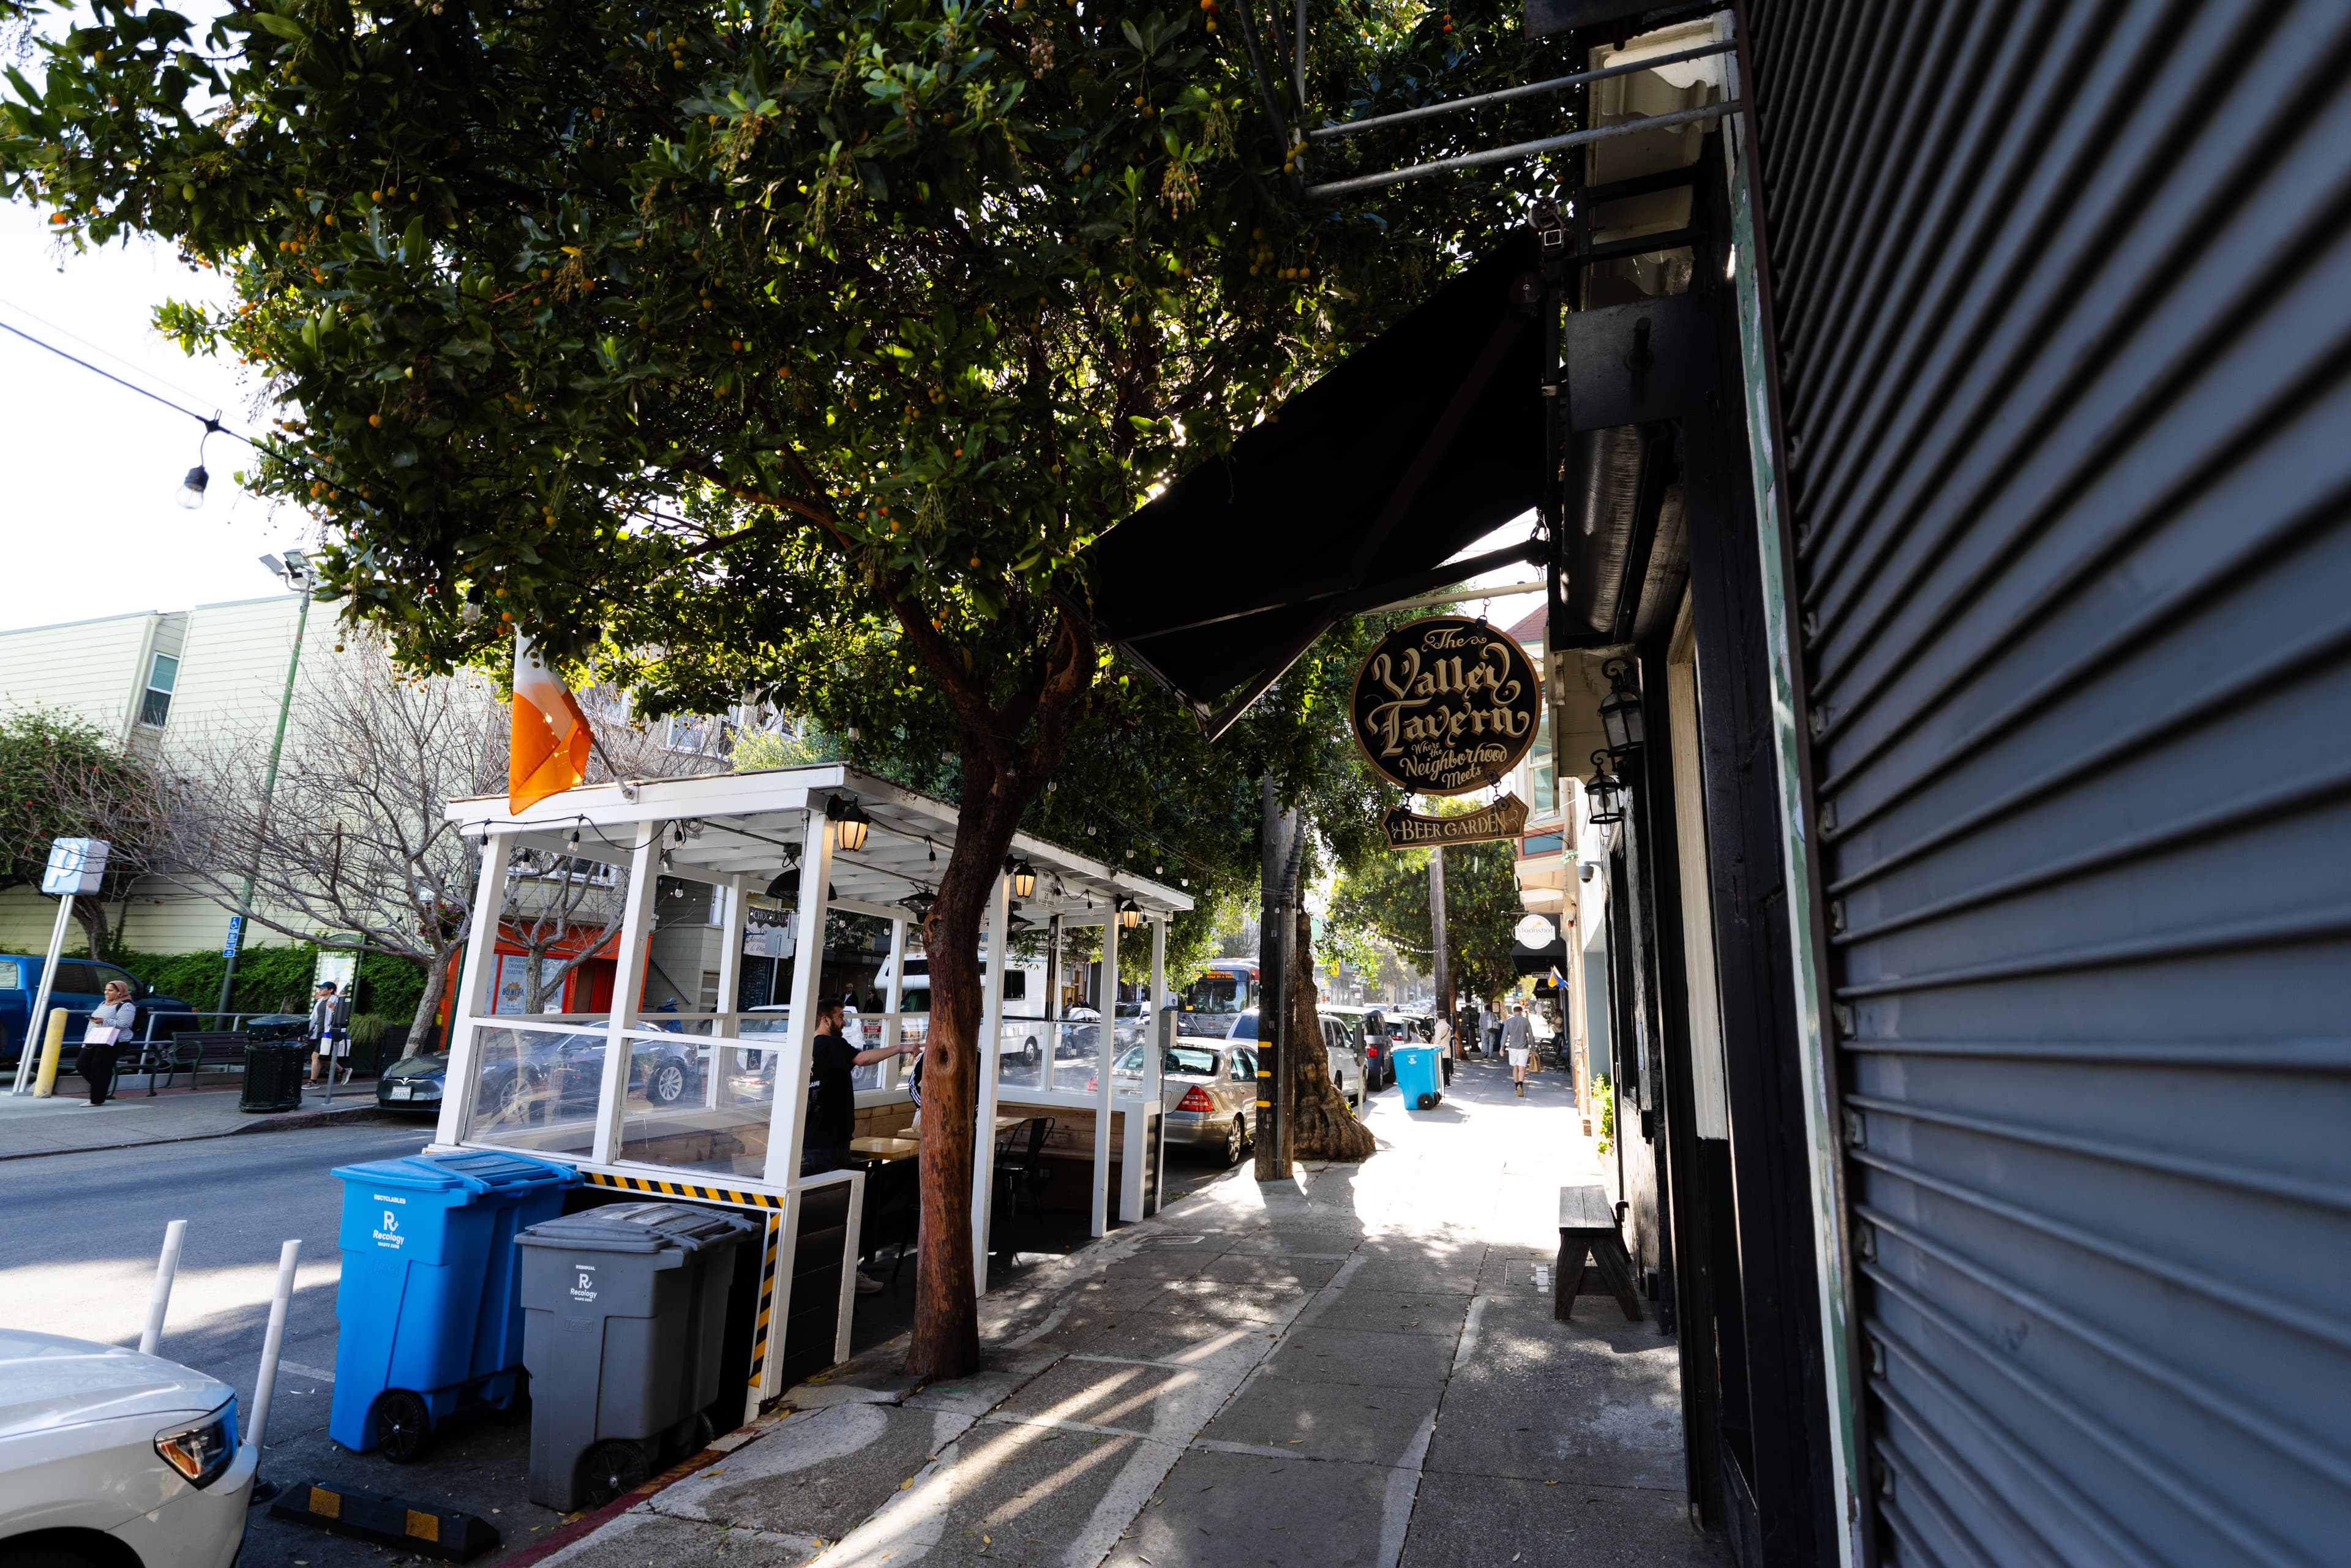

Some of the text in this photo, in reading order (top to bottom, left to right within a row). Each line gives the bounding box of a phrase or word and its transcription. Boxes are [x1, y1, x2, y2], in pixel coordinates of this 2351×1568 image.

[1421, 626, 1487, 652] The
[1371, 643, 1521, 707] Valley
[1365, 696, 1530, 759] Tavern
[1411, 740, 1440, 756] Where
[1429, 747, 1443, 758] the
[1400, 743, 1507, 781] Neighborhood
[1442, 762, 1483, 789] Meets
[1401, 811, 1506, 841] BEER GARDEN
[373, 1194, 406, 1204] RECYCLABLES
[373, 1229, 404, 1245] Recology
[570, 1288, 598, 1299] Recology
